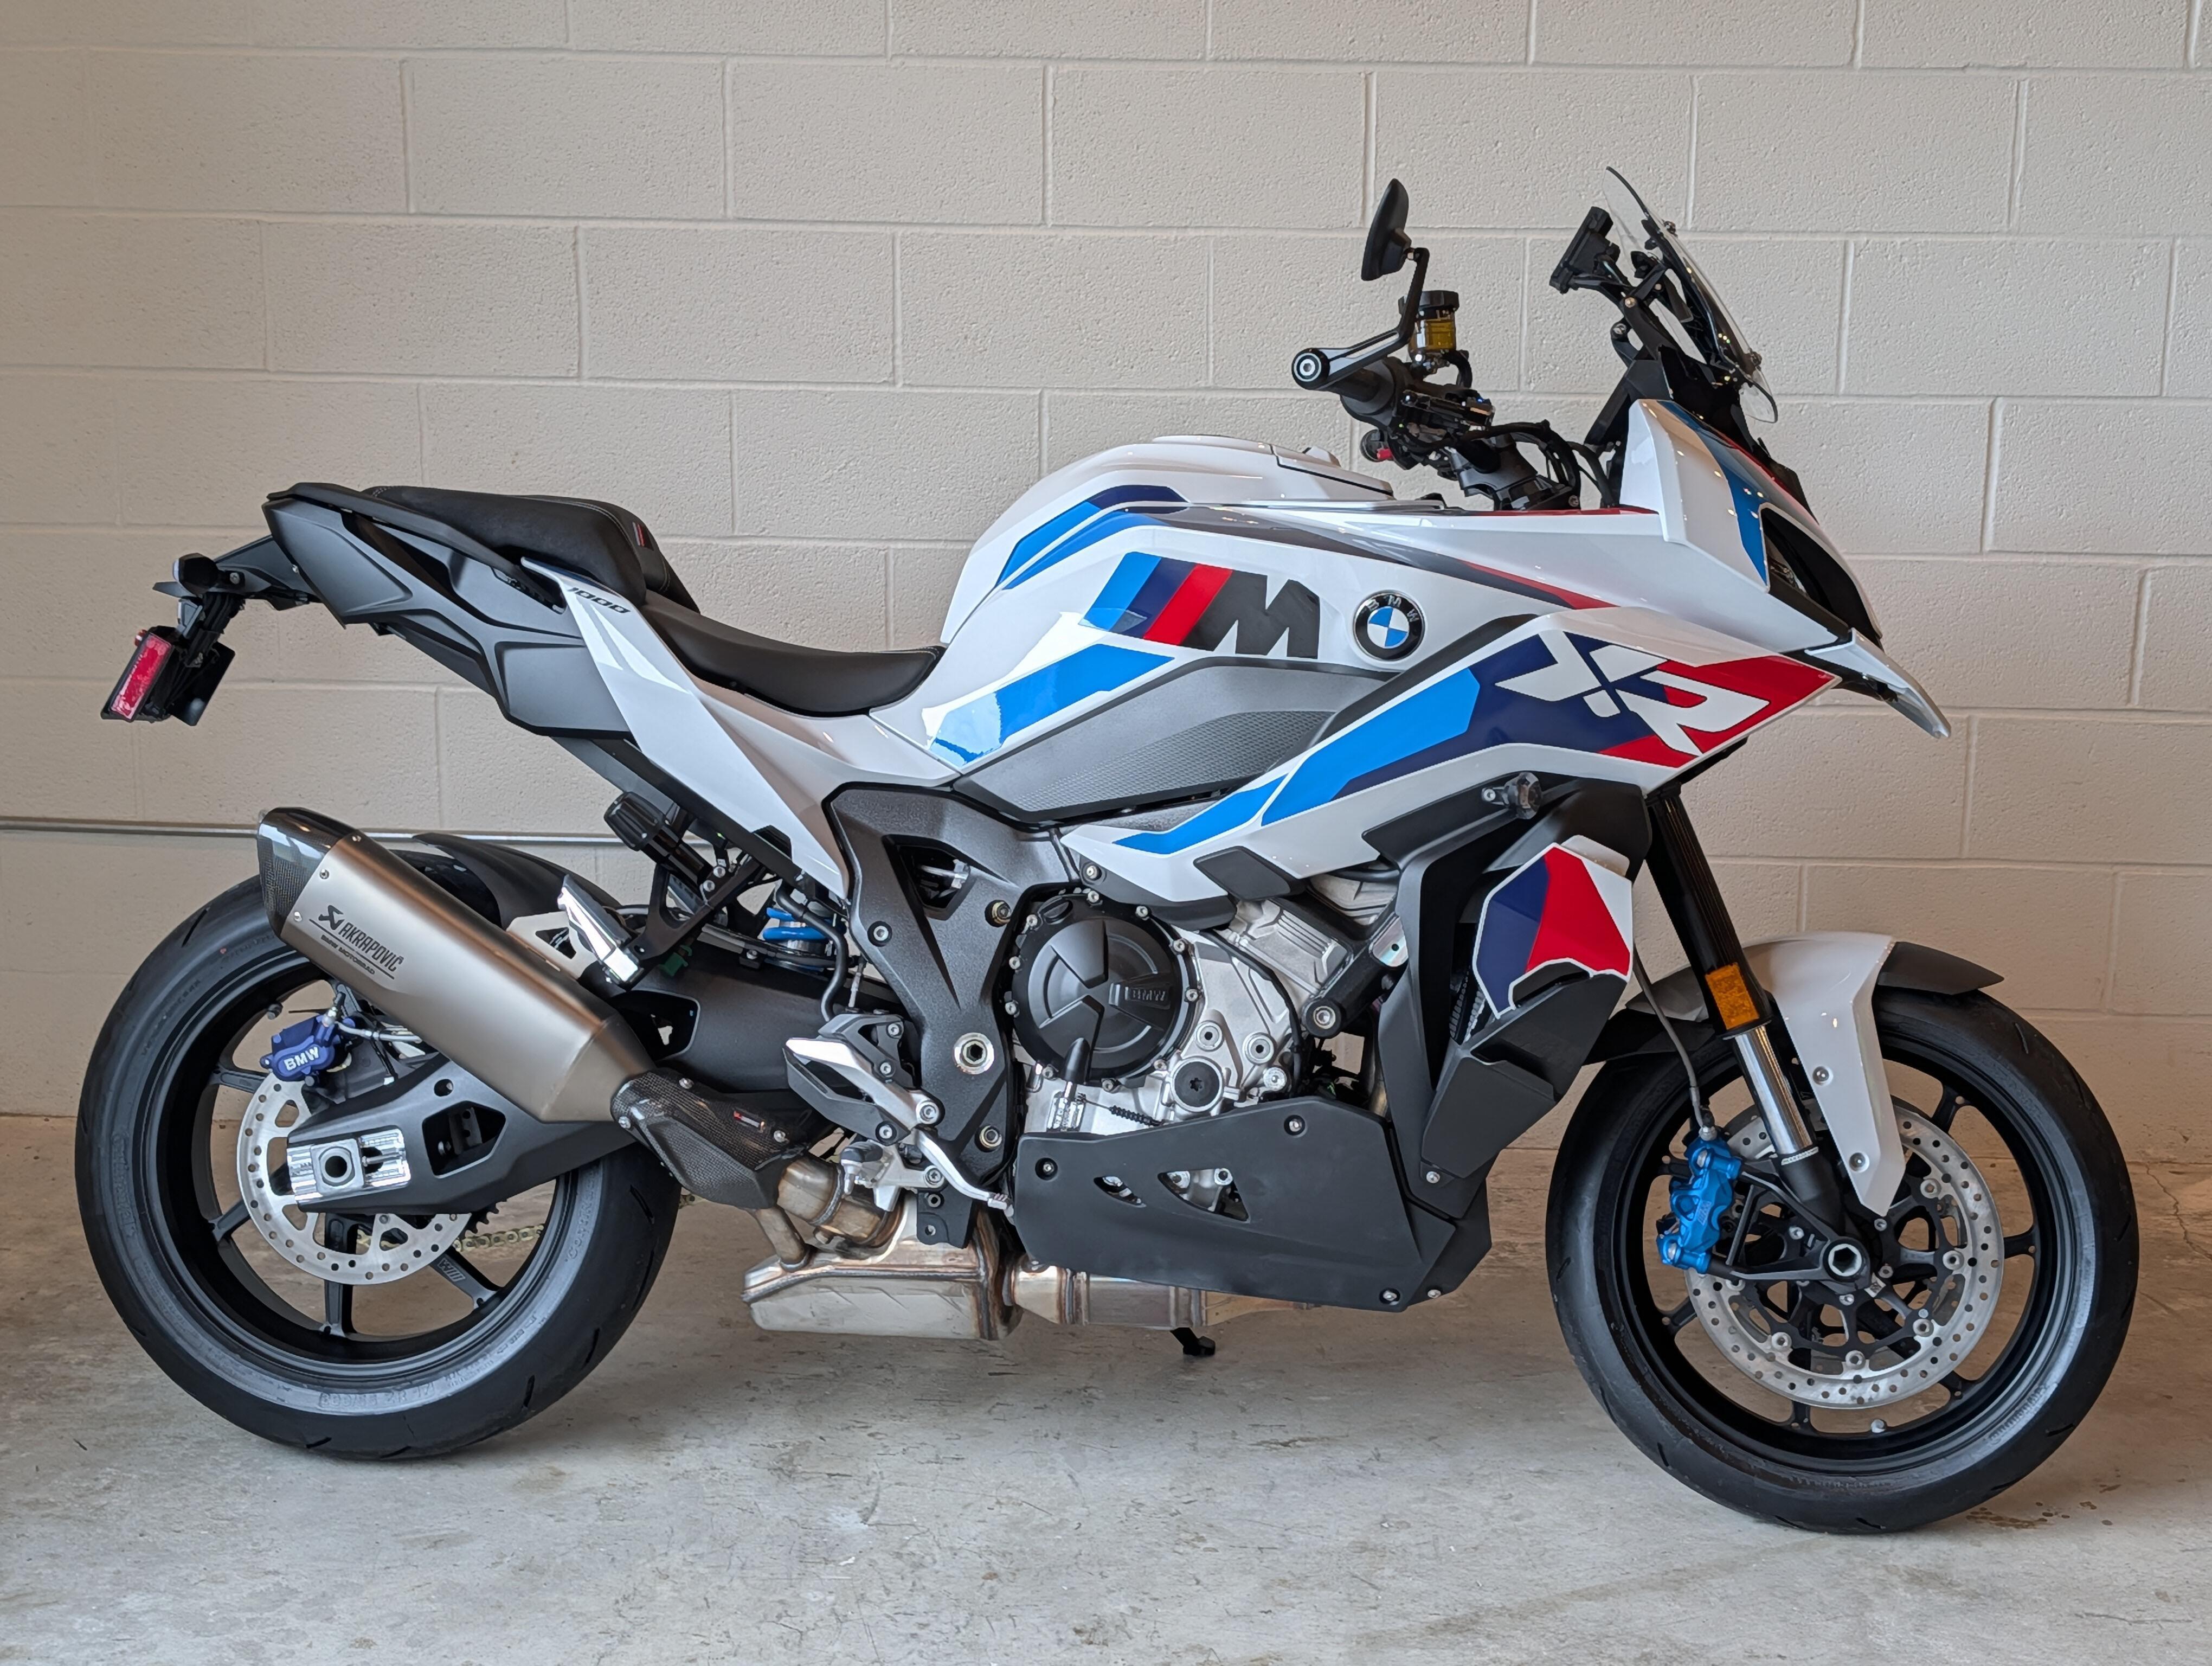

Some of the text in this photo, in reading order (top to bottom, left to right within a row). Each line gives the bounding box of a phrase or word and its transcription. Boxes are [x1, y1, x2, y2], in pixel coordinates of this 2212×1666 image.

[568, 587, 631, 614] 1000
[1367, 595, 1420, 623] BMW
[1495, 630, 1770, 756] XR
[1132, 989, 1166, 1002] BMW
[284, 1046, 319, 1071] BMW
